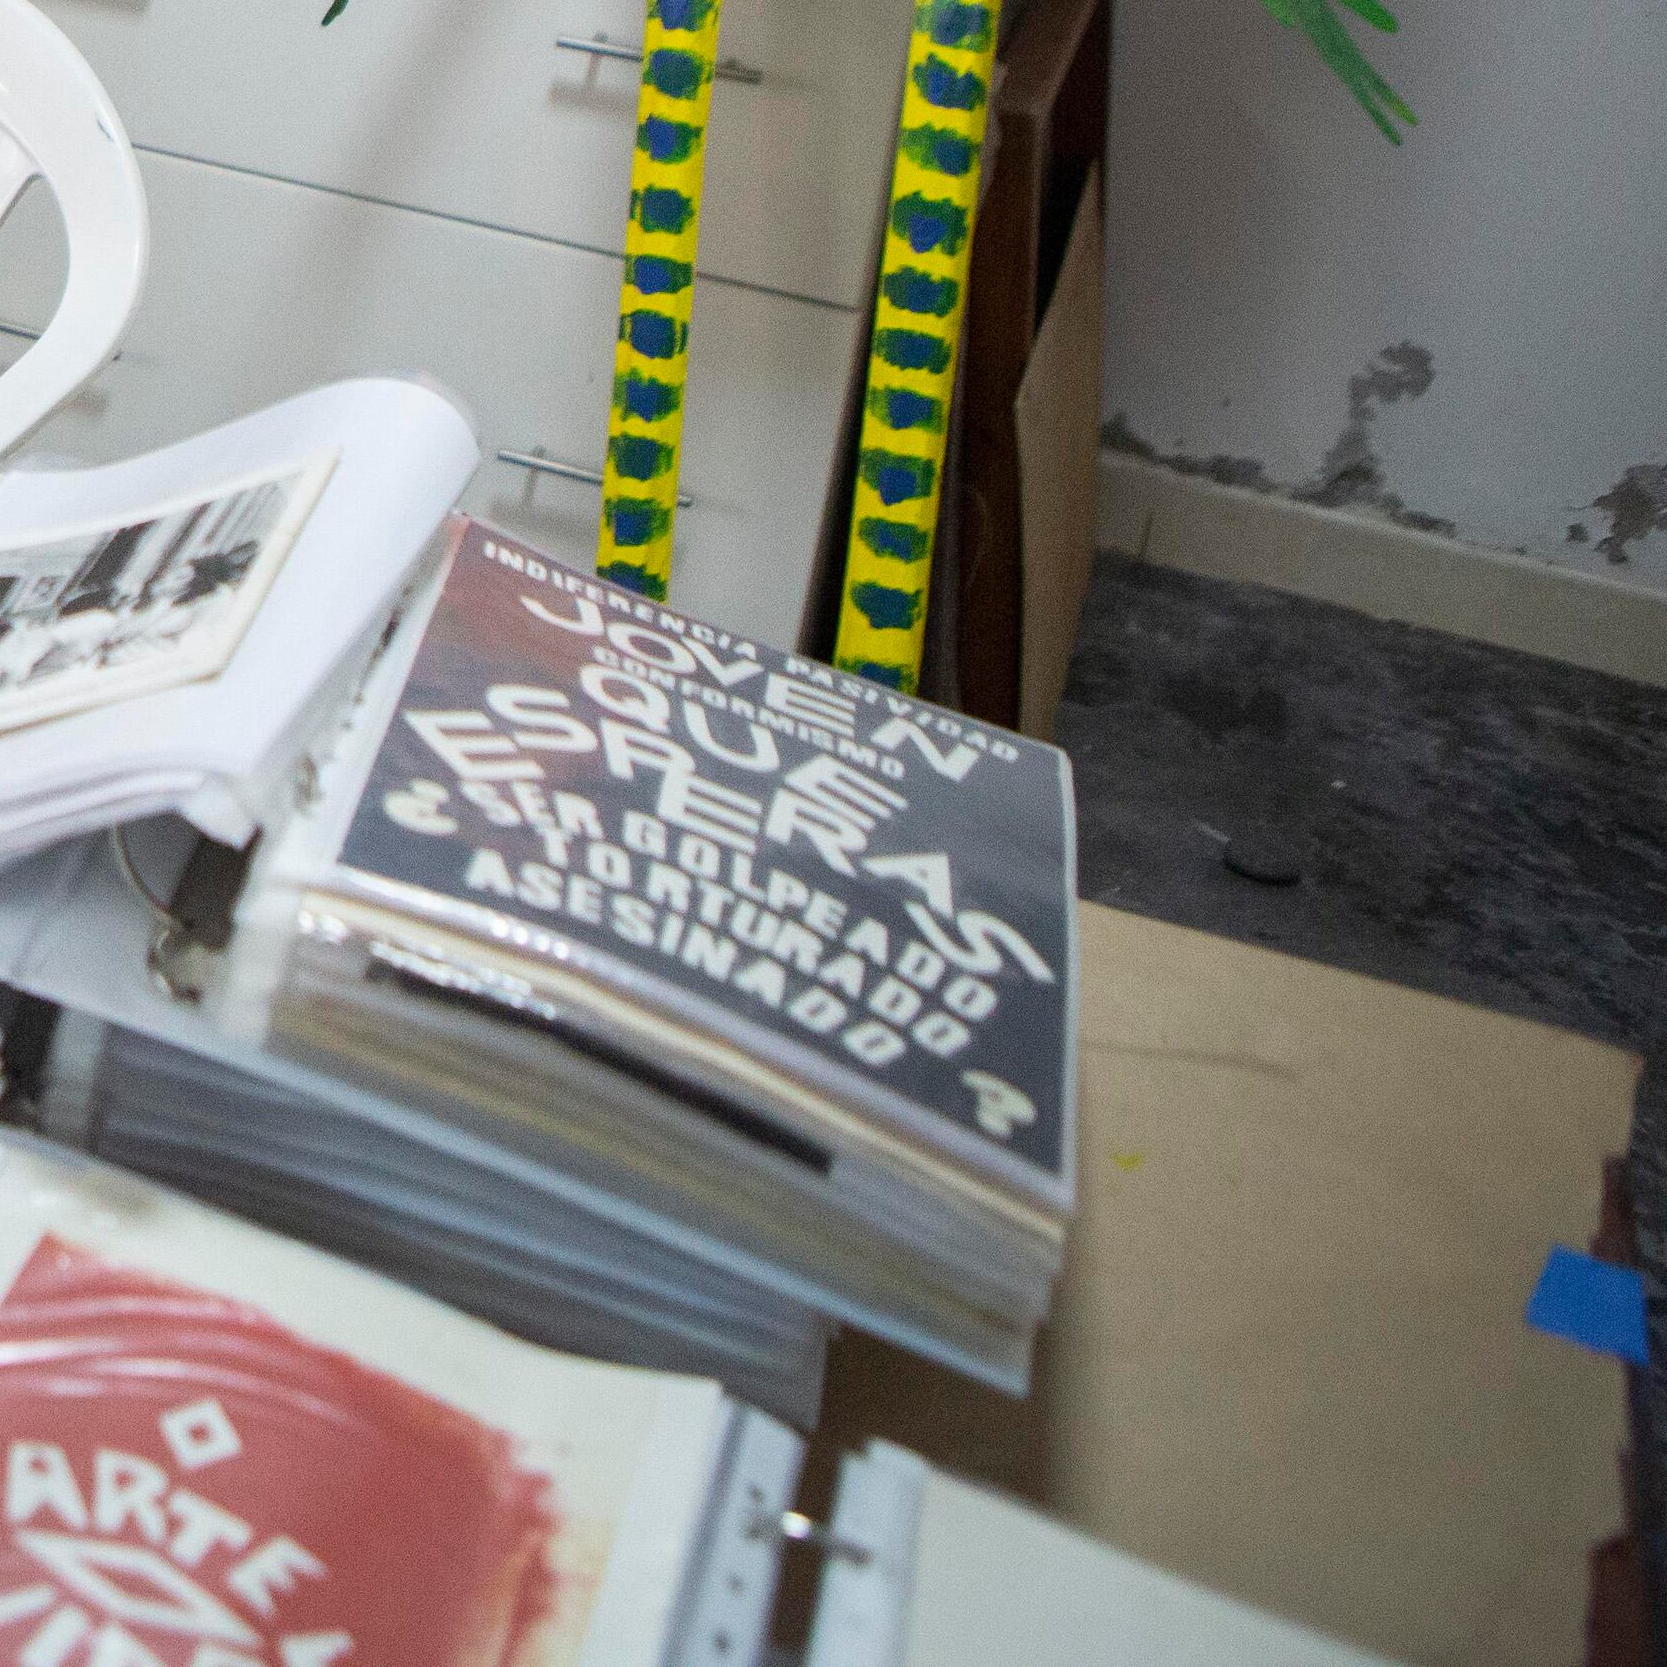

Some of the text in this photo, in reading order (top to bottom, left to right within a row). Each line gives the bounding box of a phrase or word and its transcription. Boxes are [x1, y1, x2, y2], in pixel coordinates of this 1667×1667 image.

[482, 541, 1021, 764] INDIFERENCIA PASIVIDAD
[520, 594, 980, 783] JOVEN
[579, 661, 909, 833] QUE
[593, 646, 906, 781] CONFORMISMO
[402, 683, 1055, 986] ESPERAS
[537, 822, 972, 1058] TORTURADO
[623, 810, 998, 1024] GOLPEADO
[466, 847, 907, 1068] ASESINADO
[3, 1440, 329, 1622] ARTE
